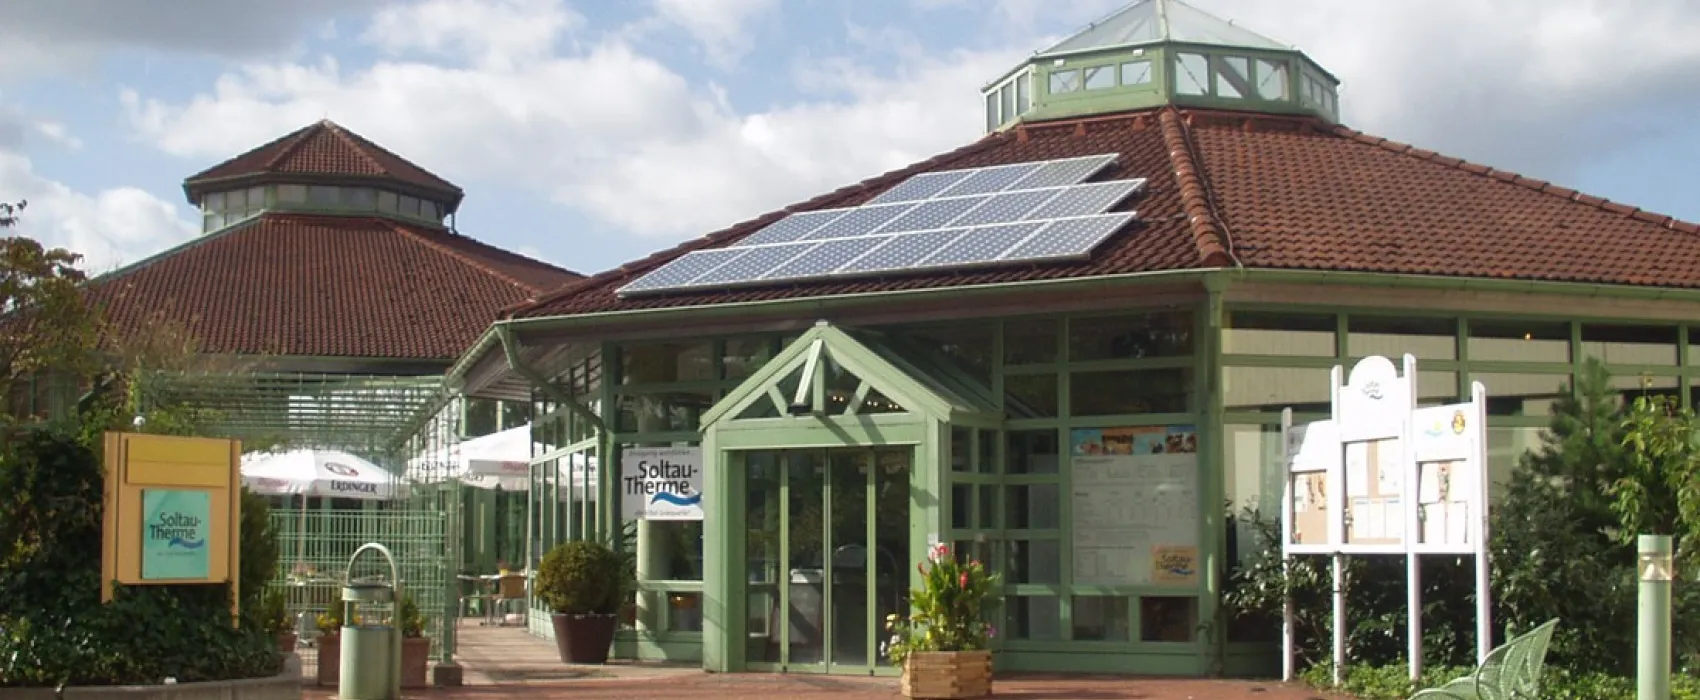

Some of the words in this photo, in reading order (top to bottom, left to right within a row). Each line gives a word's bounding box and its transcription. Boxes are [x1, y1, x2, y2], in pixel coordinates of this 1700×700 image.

[638, 459, 698, 478] Soltau-
[331, 479, 377, 494] ERDINGER
[624, 475, 690, 495] Therme
[160, 512, 201, 526] Soltau-
[149, 524, 196, 540] Therme
